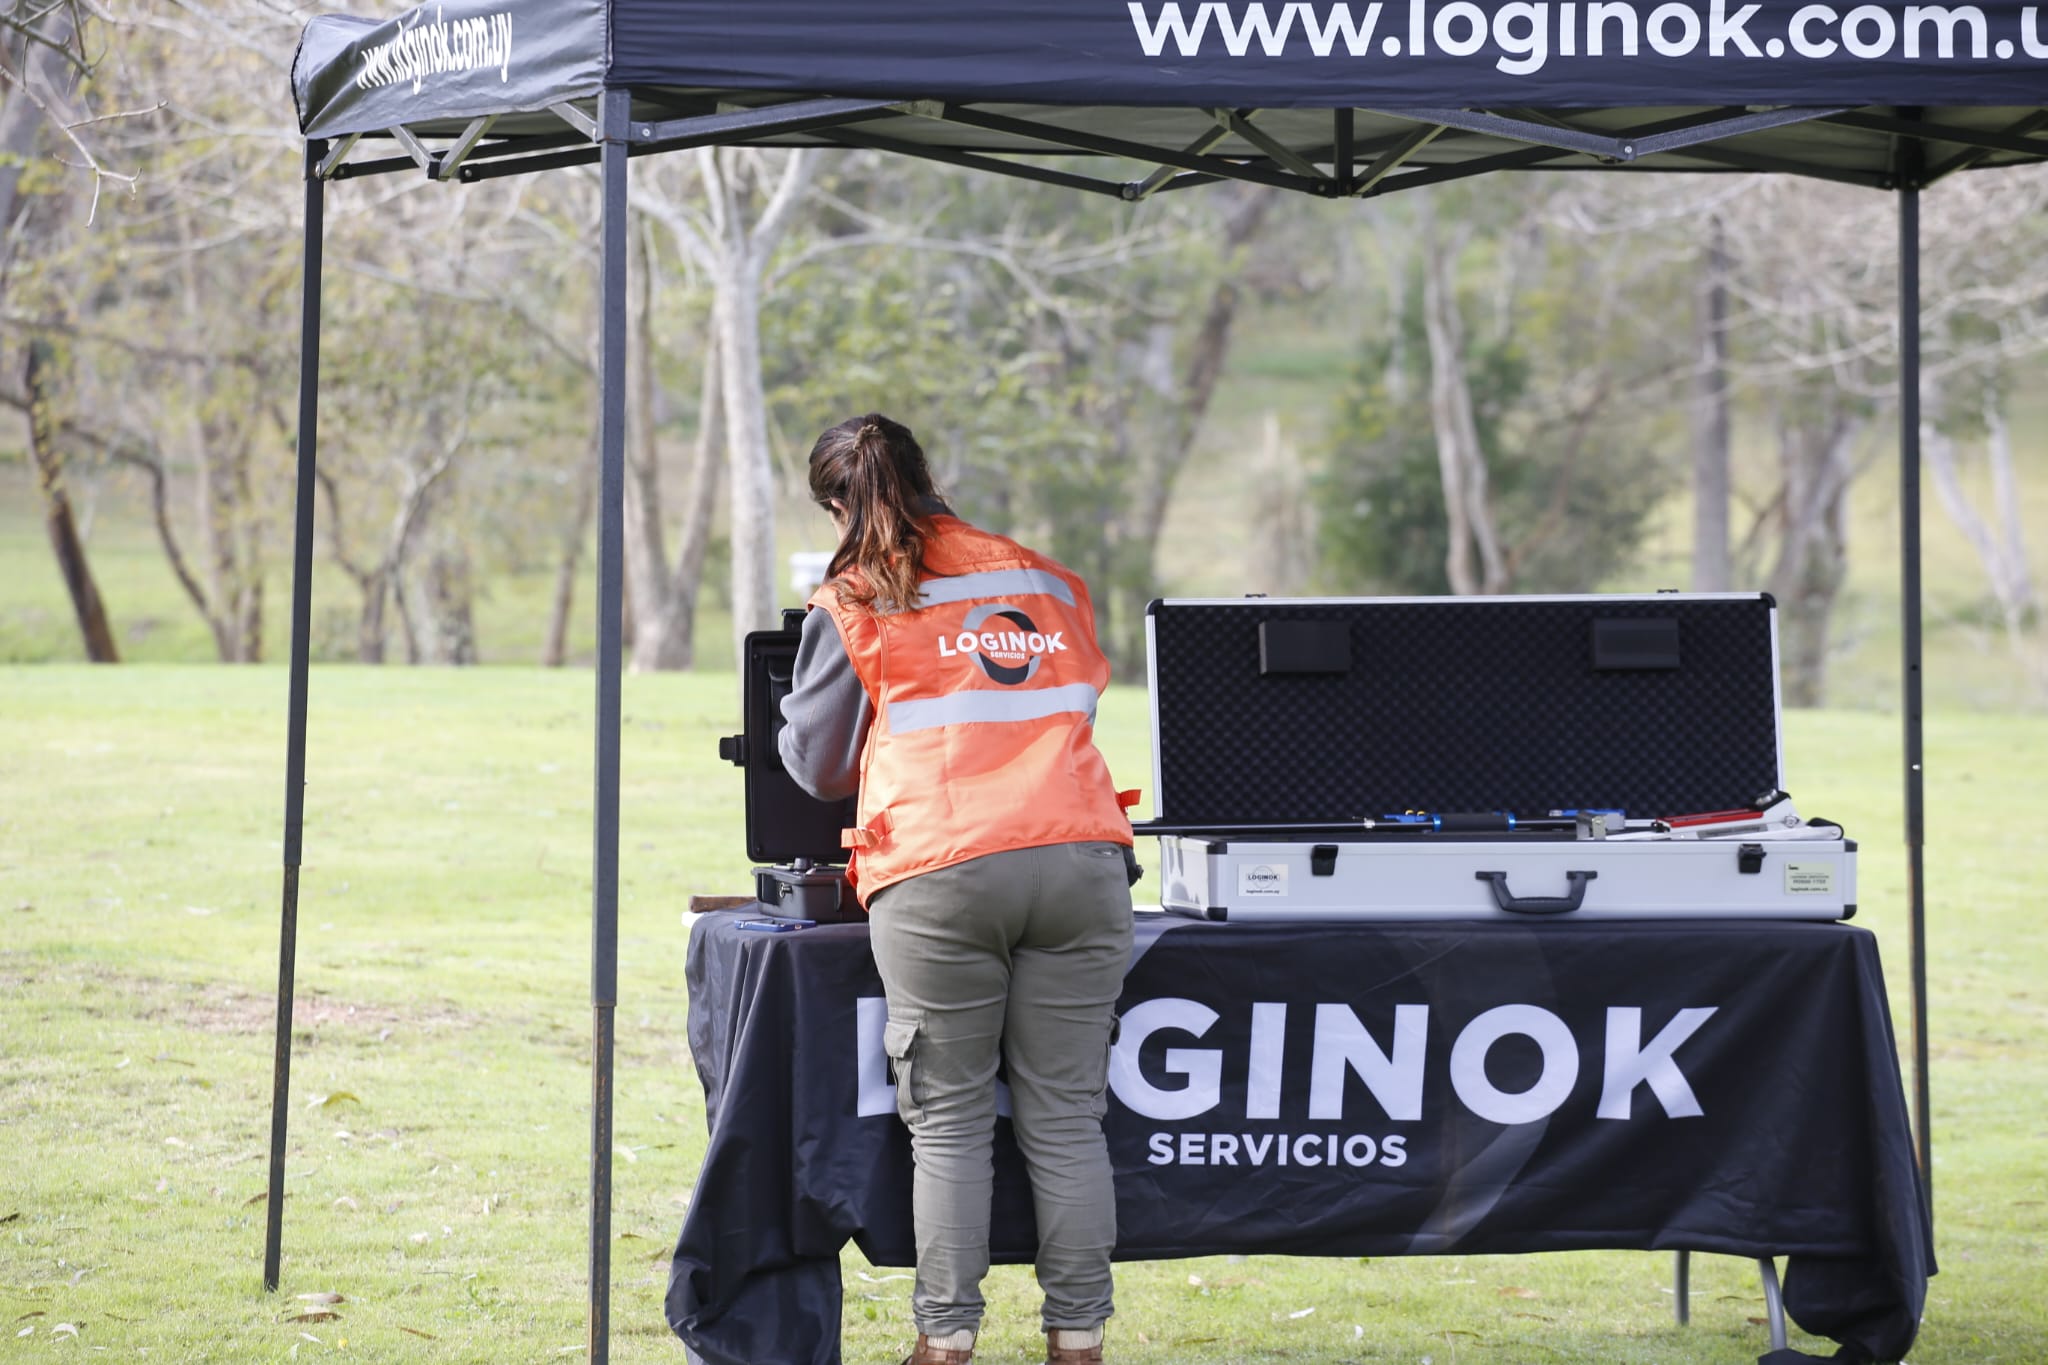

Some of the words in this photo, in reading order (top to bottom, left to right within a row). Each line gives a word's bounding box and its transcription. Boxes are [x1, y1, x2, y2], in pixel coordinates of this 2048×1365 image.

[938, 631, 1068, 657] LOGINOK
[990, 651, 1025, 660] SERVICIOS
[856, 997, 1719, 1124] LGINOK
[1147, 1132, 1408, 1167] SERVICIOS
